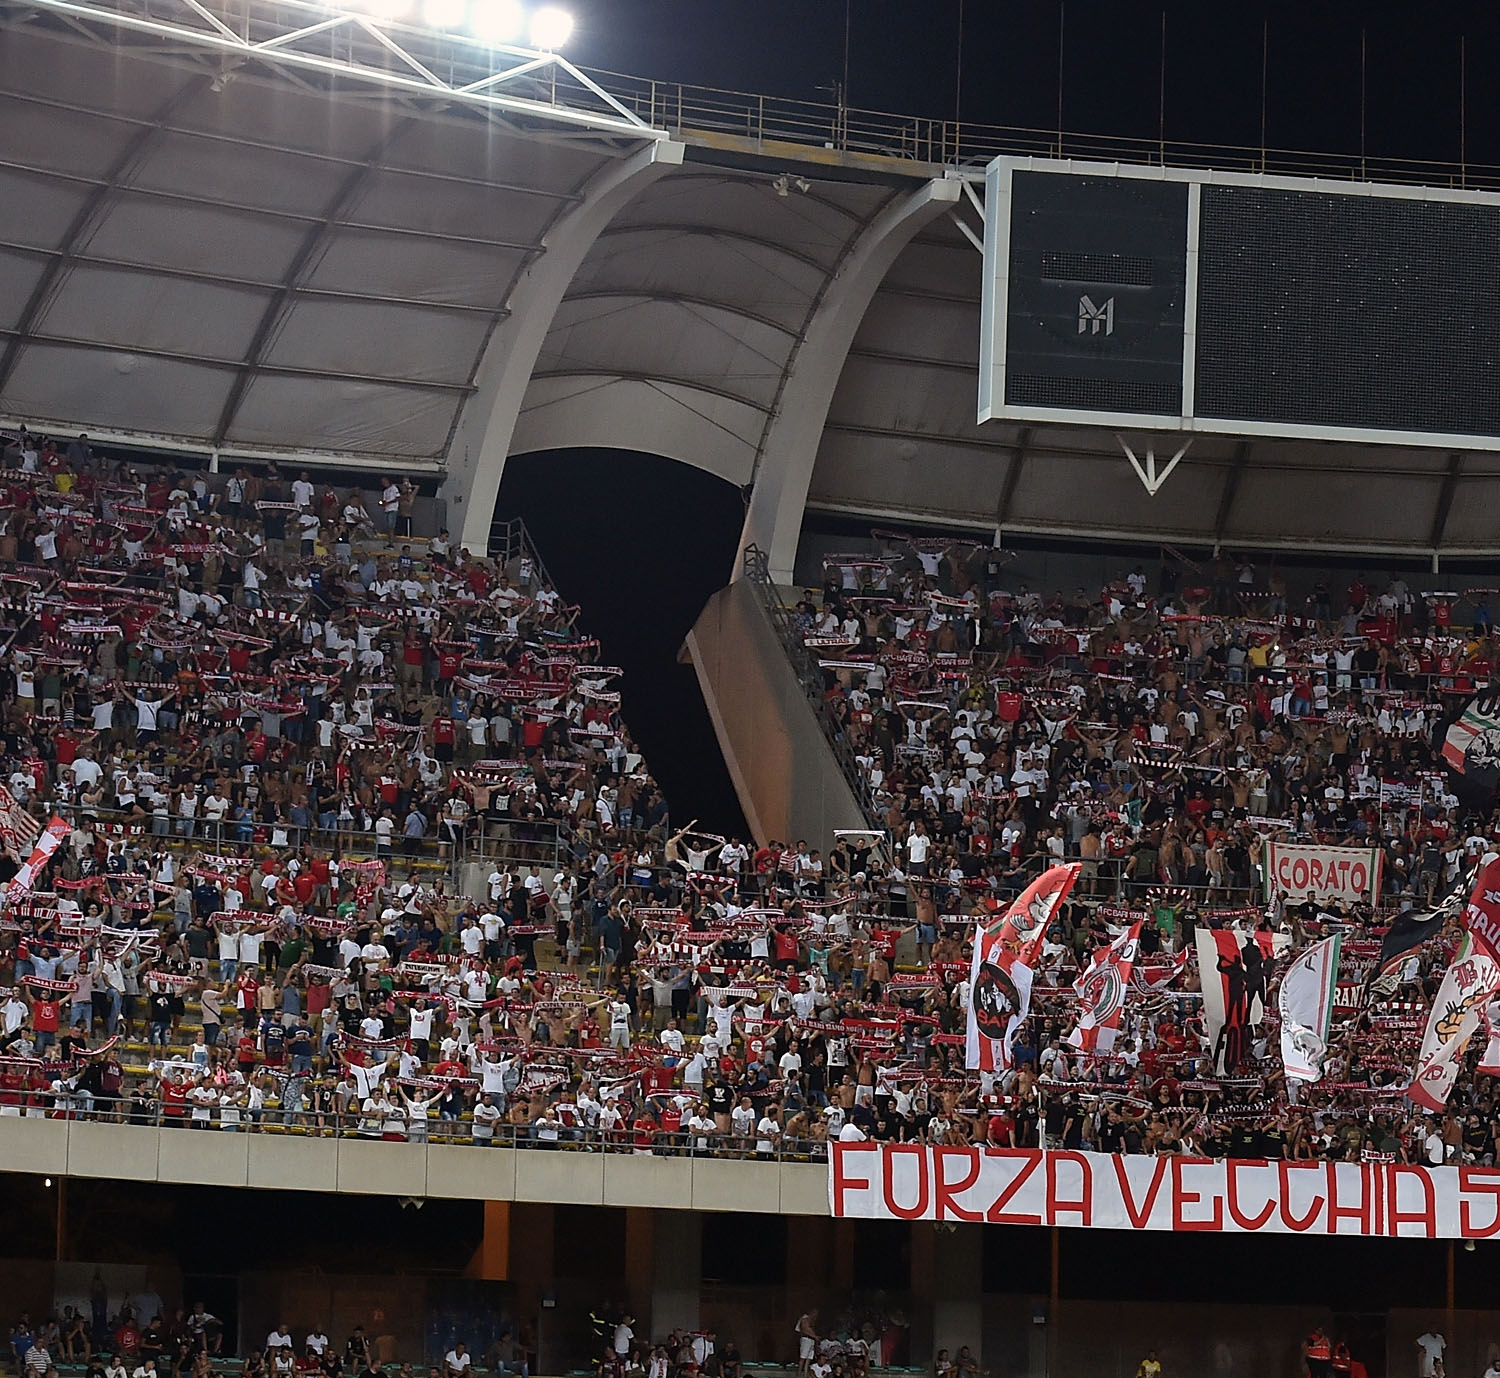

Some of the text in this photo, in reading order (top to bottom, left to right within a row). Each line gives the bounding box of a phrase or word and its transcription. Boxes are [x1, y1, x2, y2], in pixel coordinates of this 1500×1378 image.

[816, 638, 849, 646] ULTRAS
[1278, 856, 1367, 894] CORATO
[1102, 909, 1112, 917] FC
[1129, 912, 1143, 920] 1908
[977, 1010, 1008, 1029] BAR
[834, 1141, 1091, 1226] FORZA
[1113, 1153, 1436, 1239] VECCHIA
